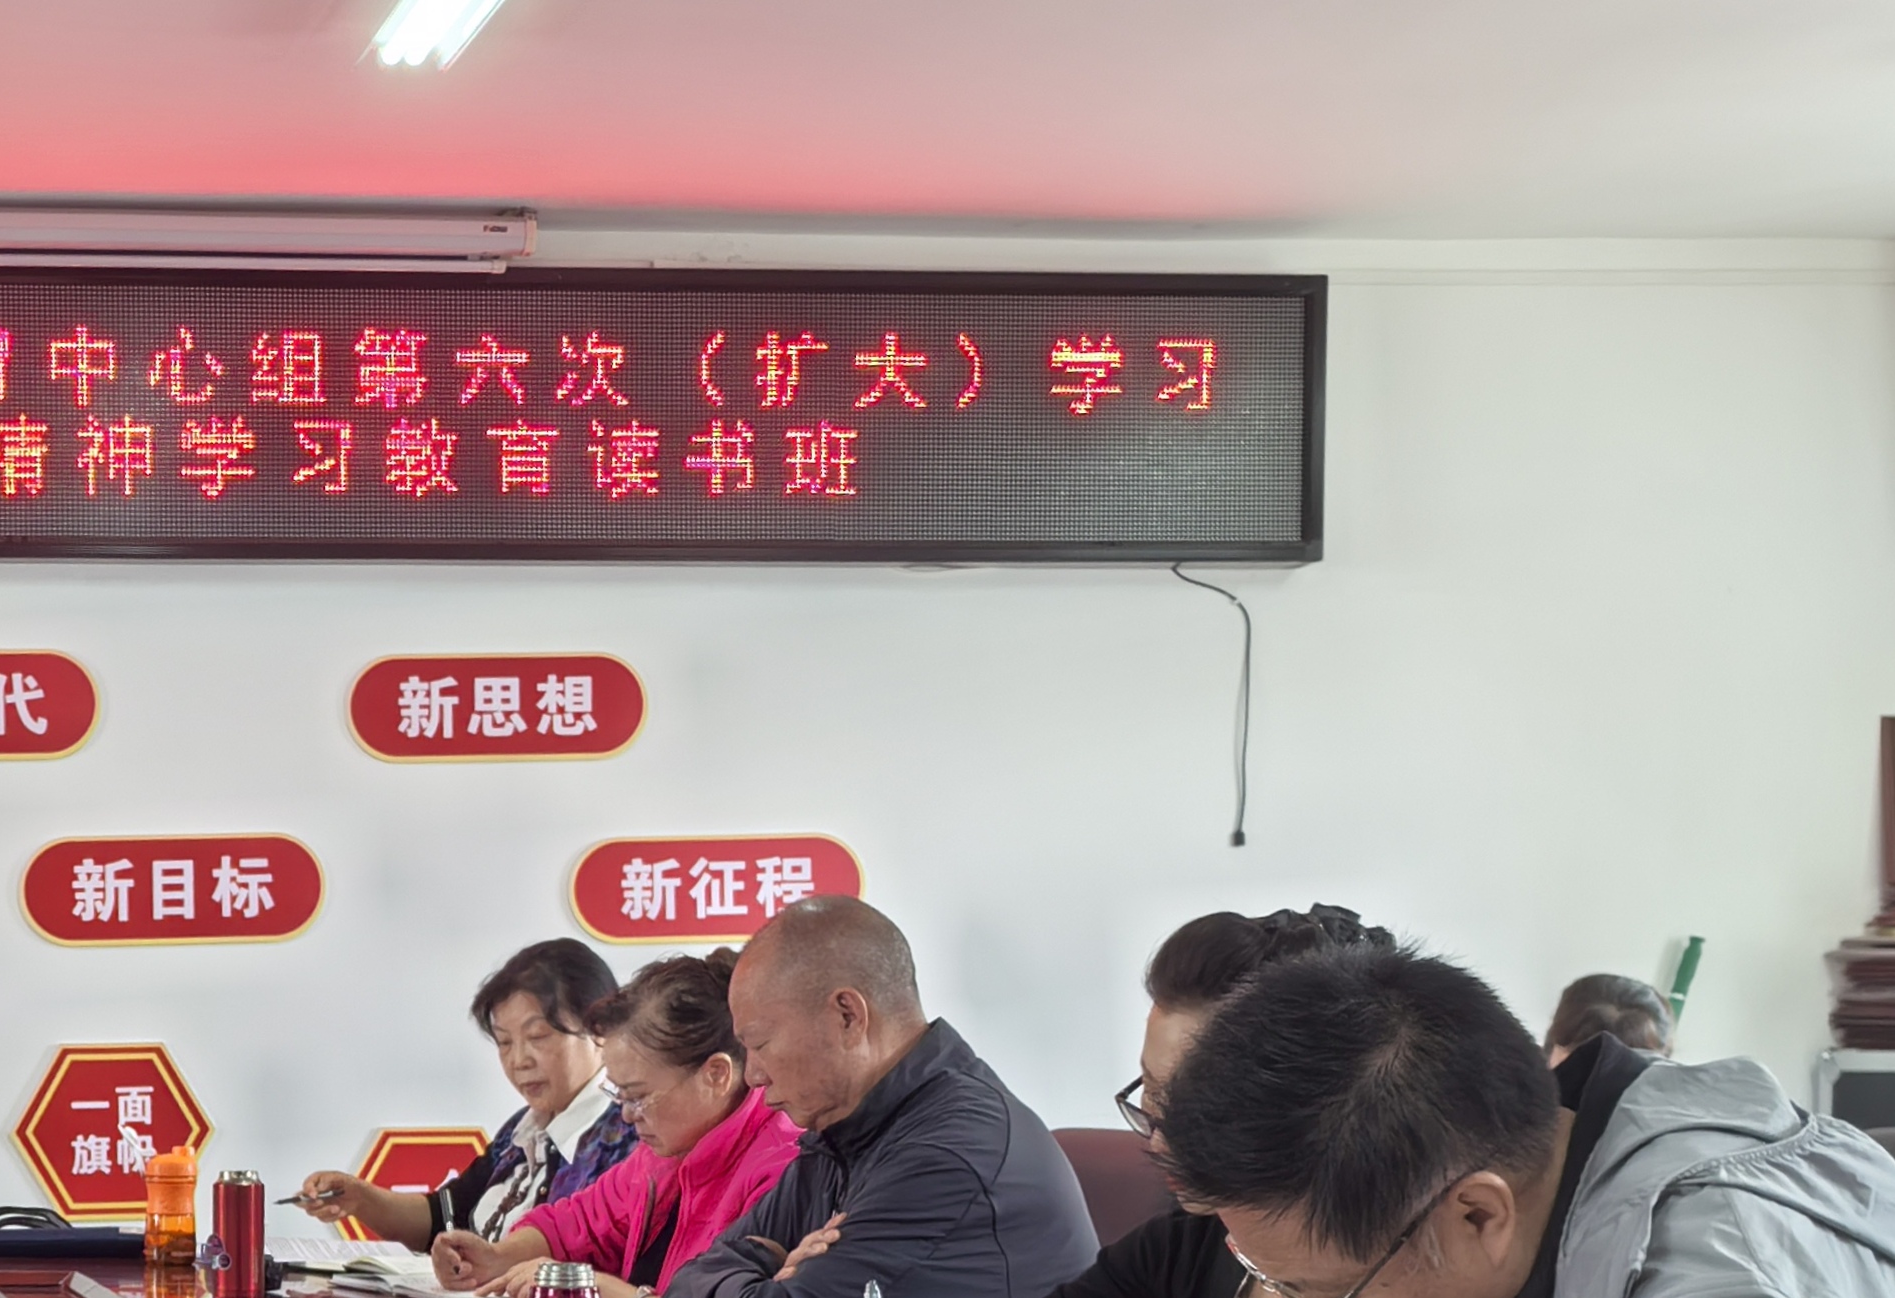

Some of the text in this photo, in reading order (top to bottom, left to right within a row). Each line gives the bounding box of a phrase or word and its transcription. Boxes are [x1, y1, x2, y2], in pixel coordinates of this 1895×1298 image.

[397, 674, 598, 739] 新思想
[71, 855, 275, 923] 新目标
[620, 856, 815, 921] 新征程
[70, 1085, 155, 1127] 一面
